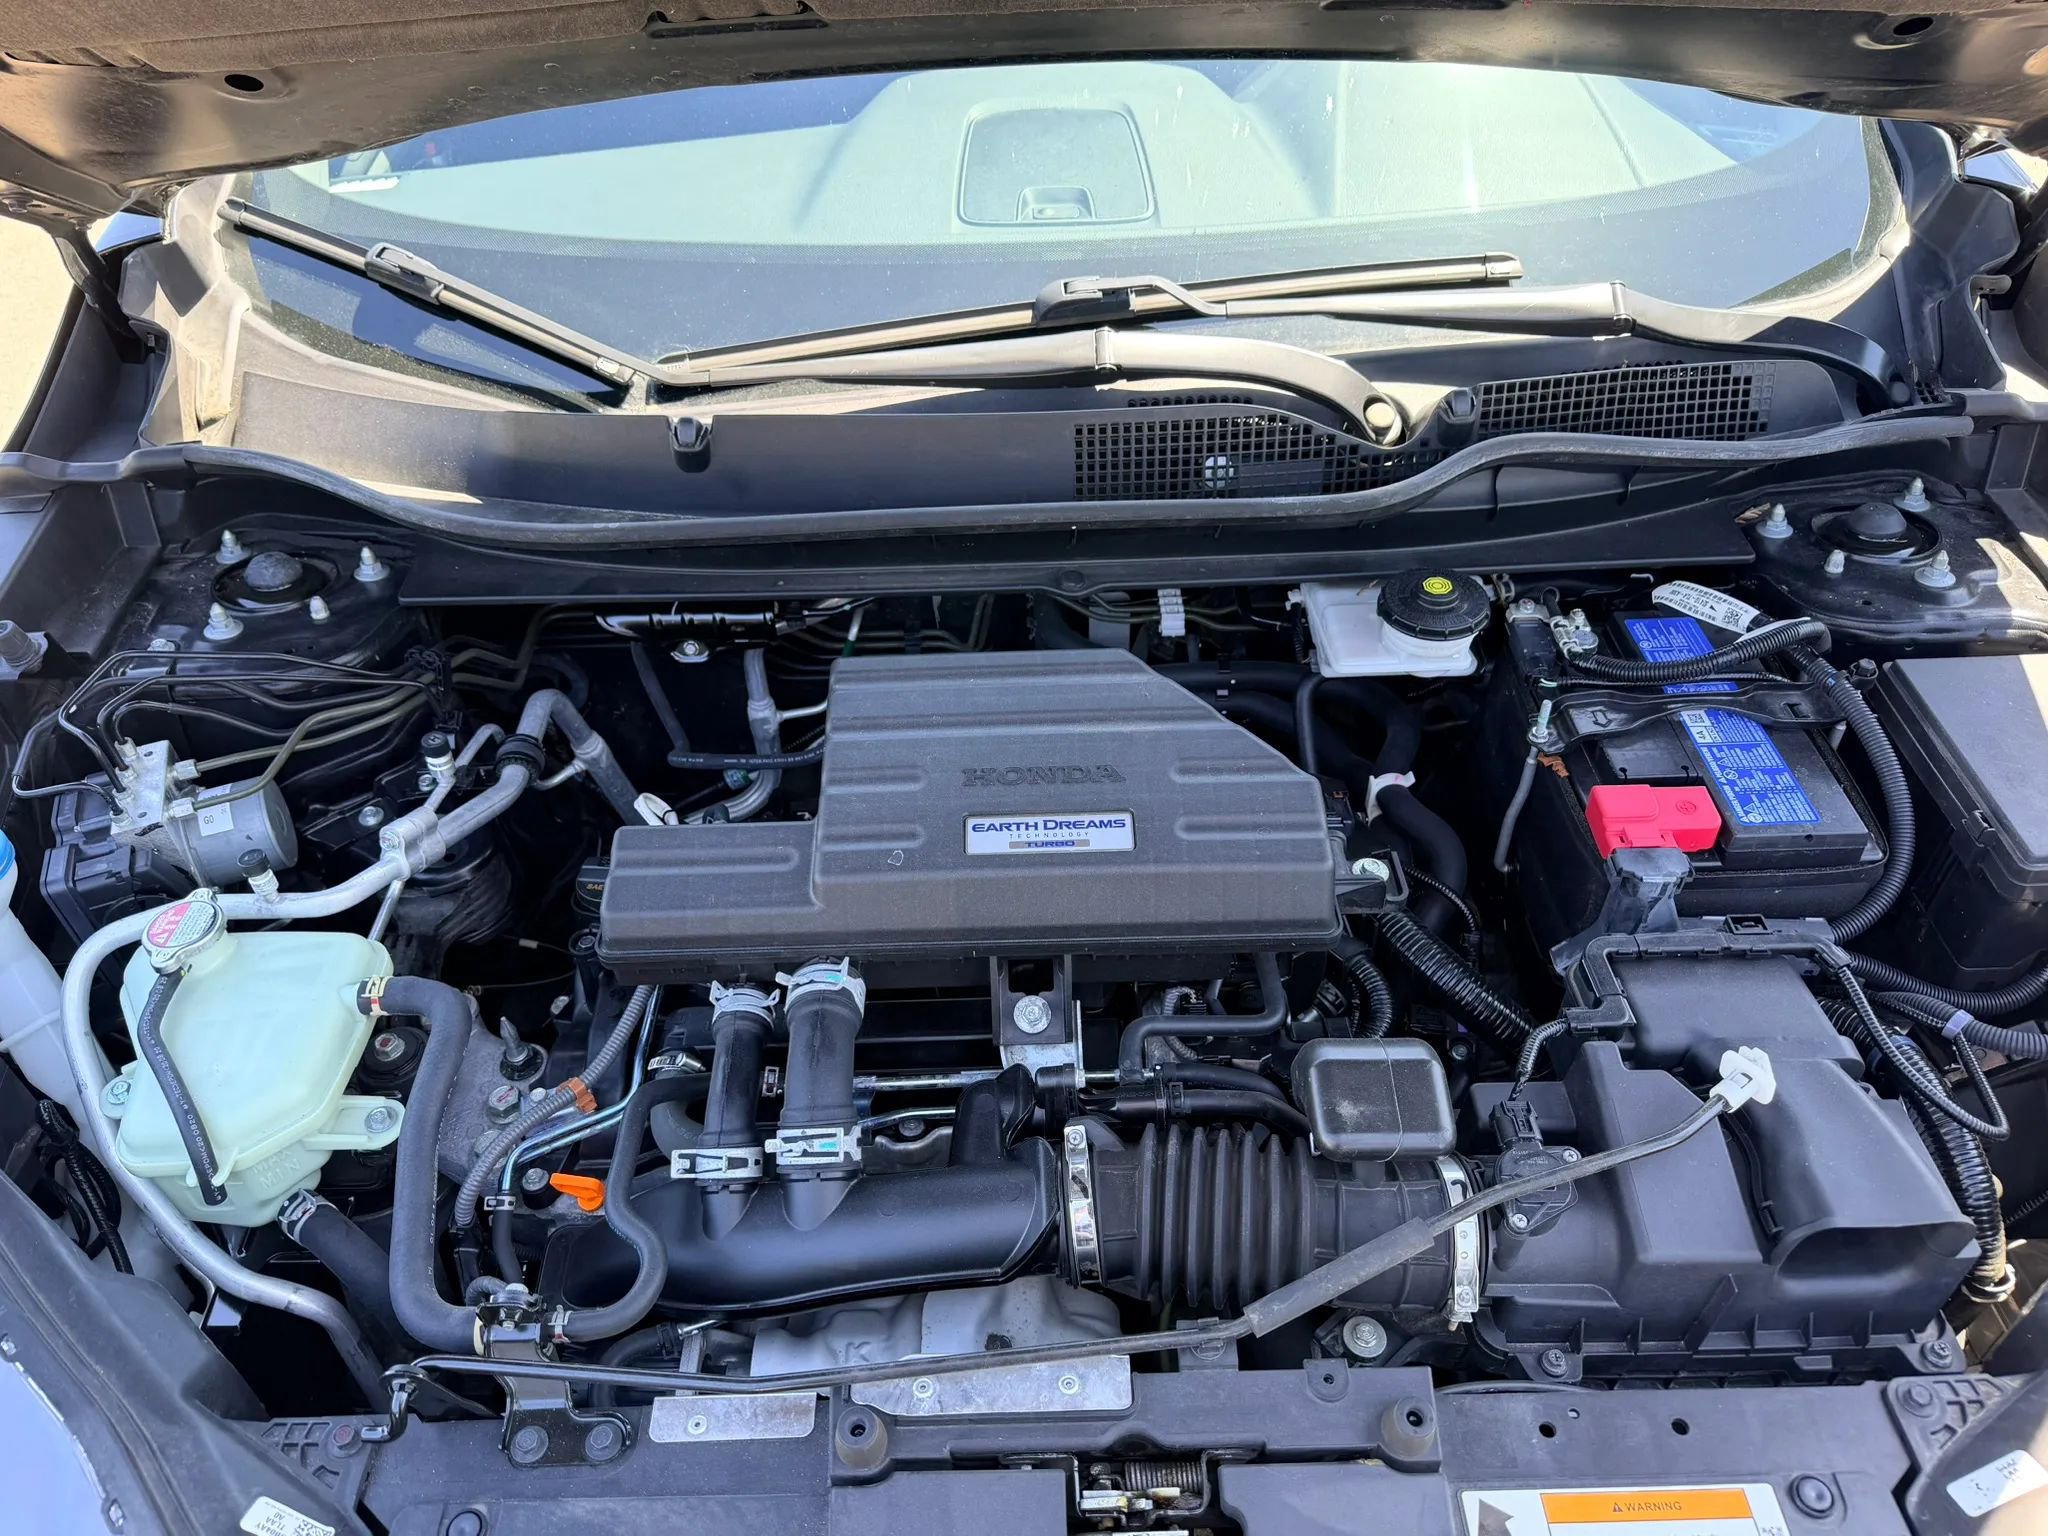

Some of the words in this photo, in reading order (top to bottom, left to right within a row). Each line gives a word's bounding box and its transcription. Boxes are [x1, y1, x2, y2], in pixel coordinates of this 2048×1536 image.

[961, 765, 1127, 787] HONDA
[971, 820, 1038, 833] EARTH
[1043, 819, 1126, 831] DREAMS
[1025, 840, 1075, 848] TURBO
[1624, 1501, 1682, 1512] WARNING
